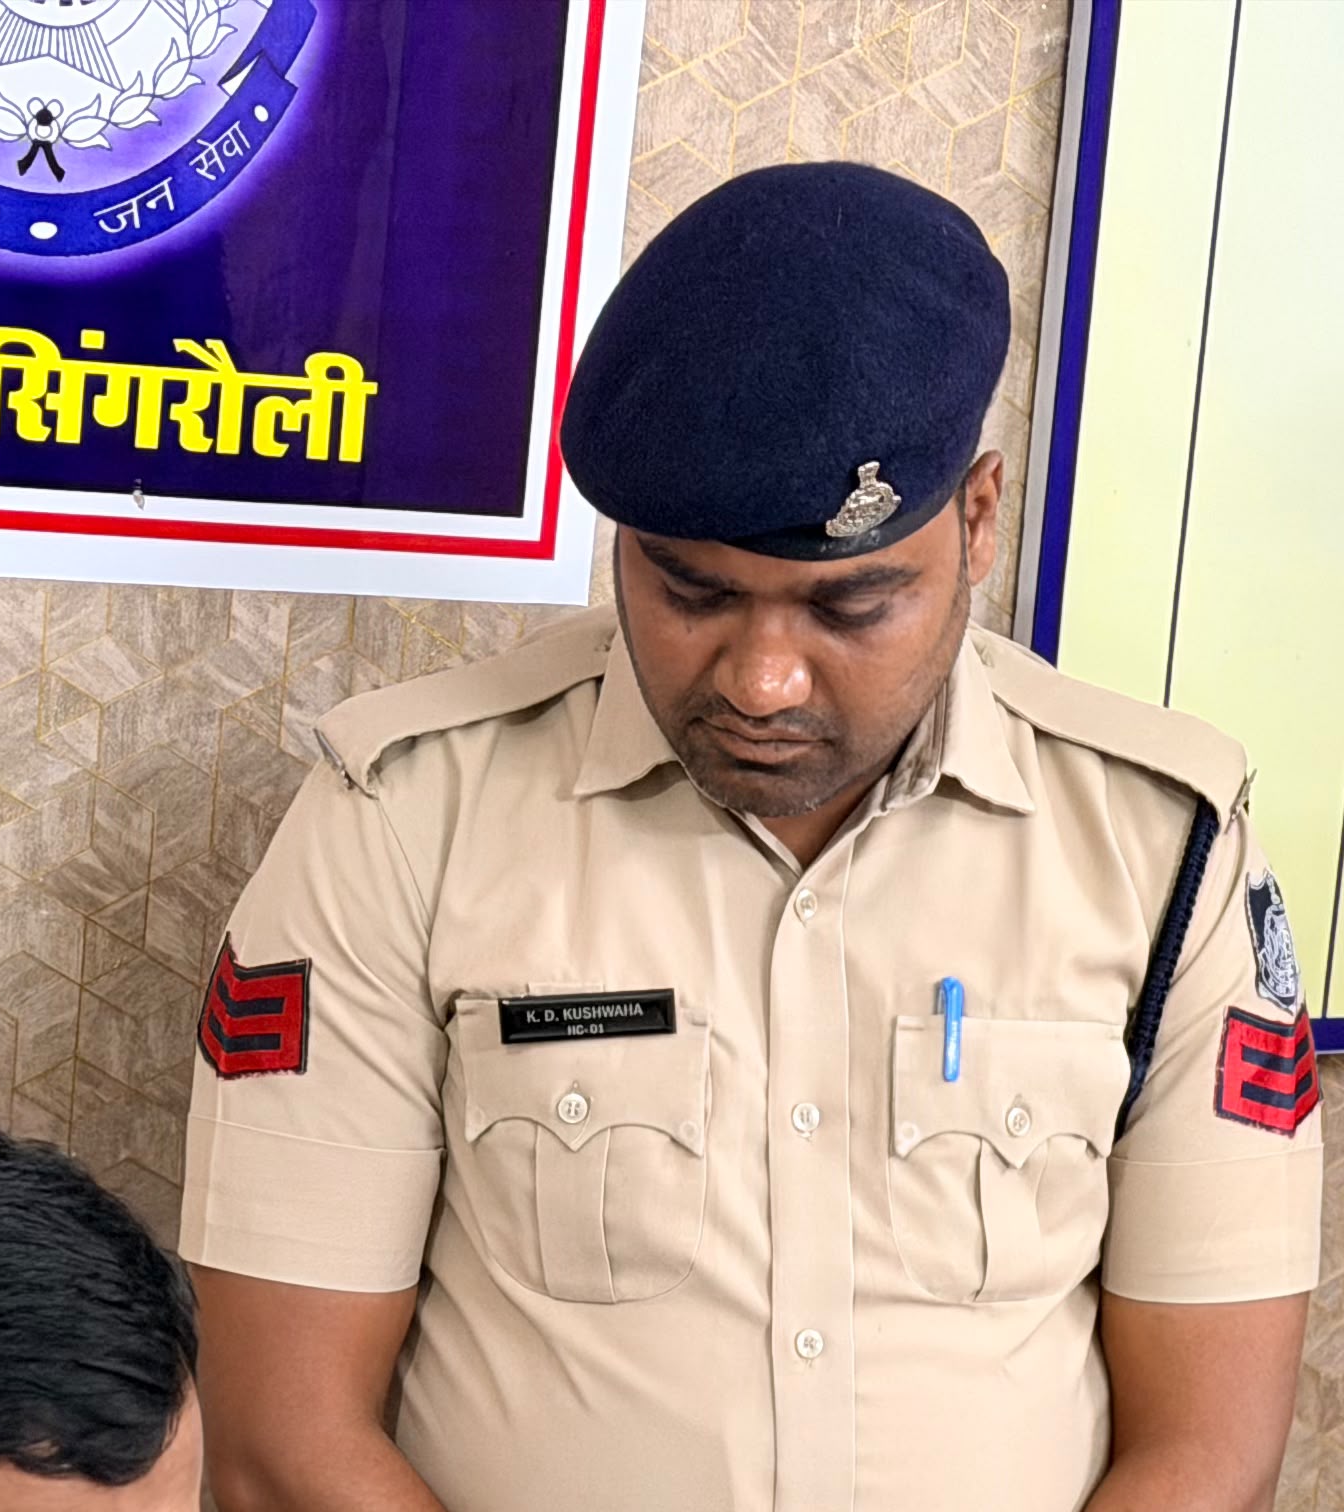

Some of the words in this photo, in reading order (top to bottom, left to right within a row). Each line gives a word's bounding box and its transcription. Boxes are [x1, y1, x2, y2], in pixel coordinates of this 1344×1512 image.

[93, 176, 177, 235] जन
[189, 121, 253, 182] सेवा
[526, 1010, 541, 1024] K.
[544, 1009, 560, 1022] D.
[562, 1003, 644, 1021] KUSHWAHA
